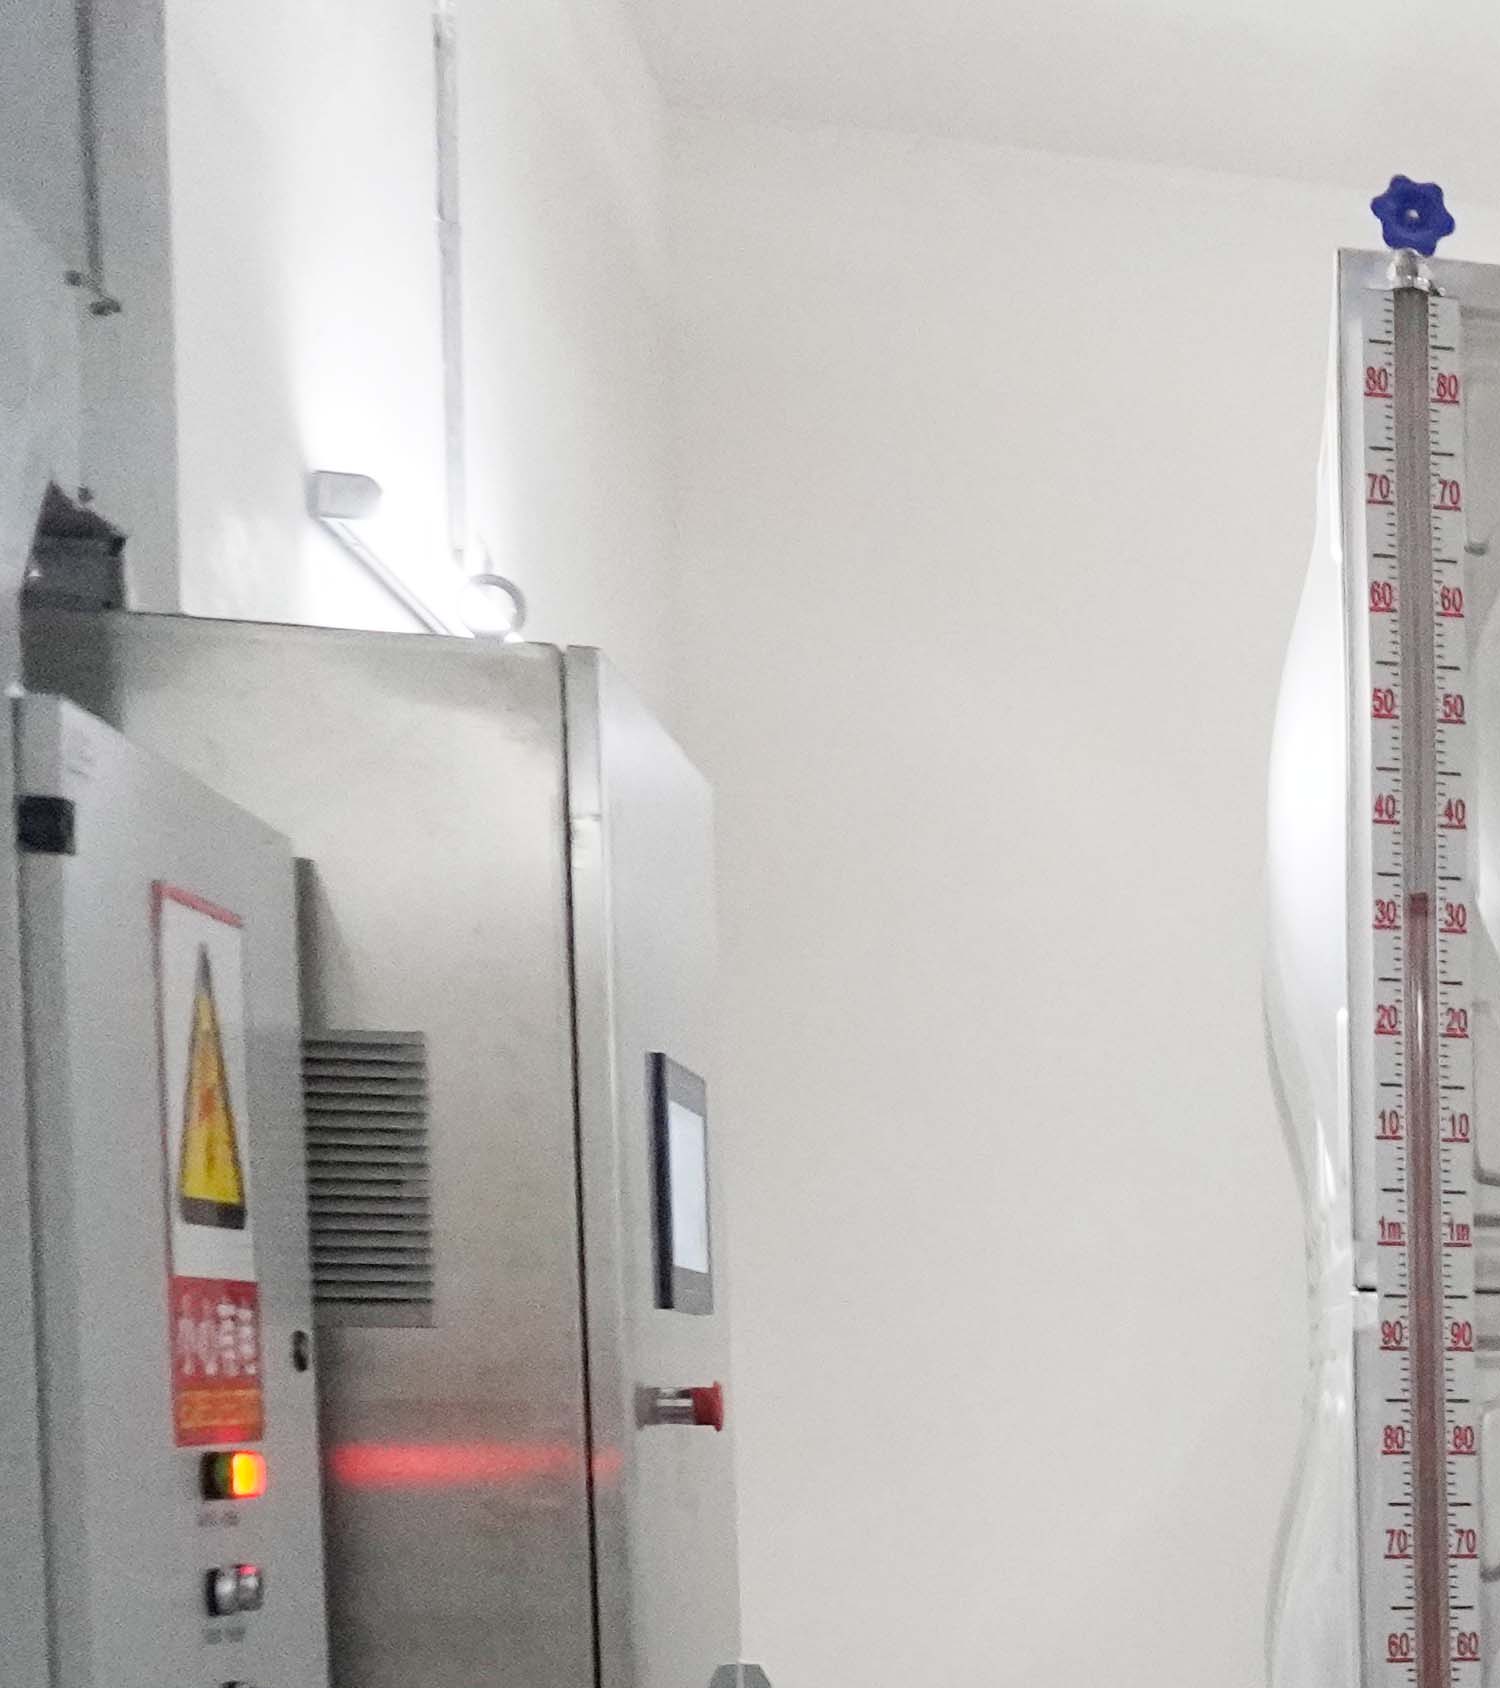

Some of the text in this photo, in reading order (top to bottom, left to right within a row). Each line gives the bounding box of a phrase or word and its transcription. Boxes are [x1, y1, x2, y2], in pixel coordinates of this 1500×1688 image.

[1367, 473, 1390, 498] 70
[1438, 479, 1461, 505] 70
[1370, 580, 1393, 607] 60
[1372, 688, 1395, 713] 50
[1442, 693, 1465, 718] 50
[1373, 795, 1396, 818] 40
[1443, 799, 1466, 824] 40
[1374, 900, 1397, 924] 30
[1445, 902, 1467, 927] 30
[1375, 1005, 1398, 1029] 20
[1446, 1006, 1468, 1032] 20
[1377, 1110, 1400, 1135] 10
[1449, 1112, 1470, 1137] 10
[1378, 1216, 1401, 1240] 1m
[1450, 1219, 1471, 1242] 1m
[1380, 1320, 1403, 1346] 90
[1450, 1320, 1472, 1347] 90
[1383, 1425, 1405, 1450] 80
[1452, 1424, 1475, 1450] 80
[1385, 1529, 1408, 1554] 70
[1454, 1528, 1477, 1554] 70
[1387, 1633, 1410, 1657] 60
[1456, 1631, 1479, 1657] 60
